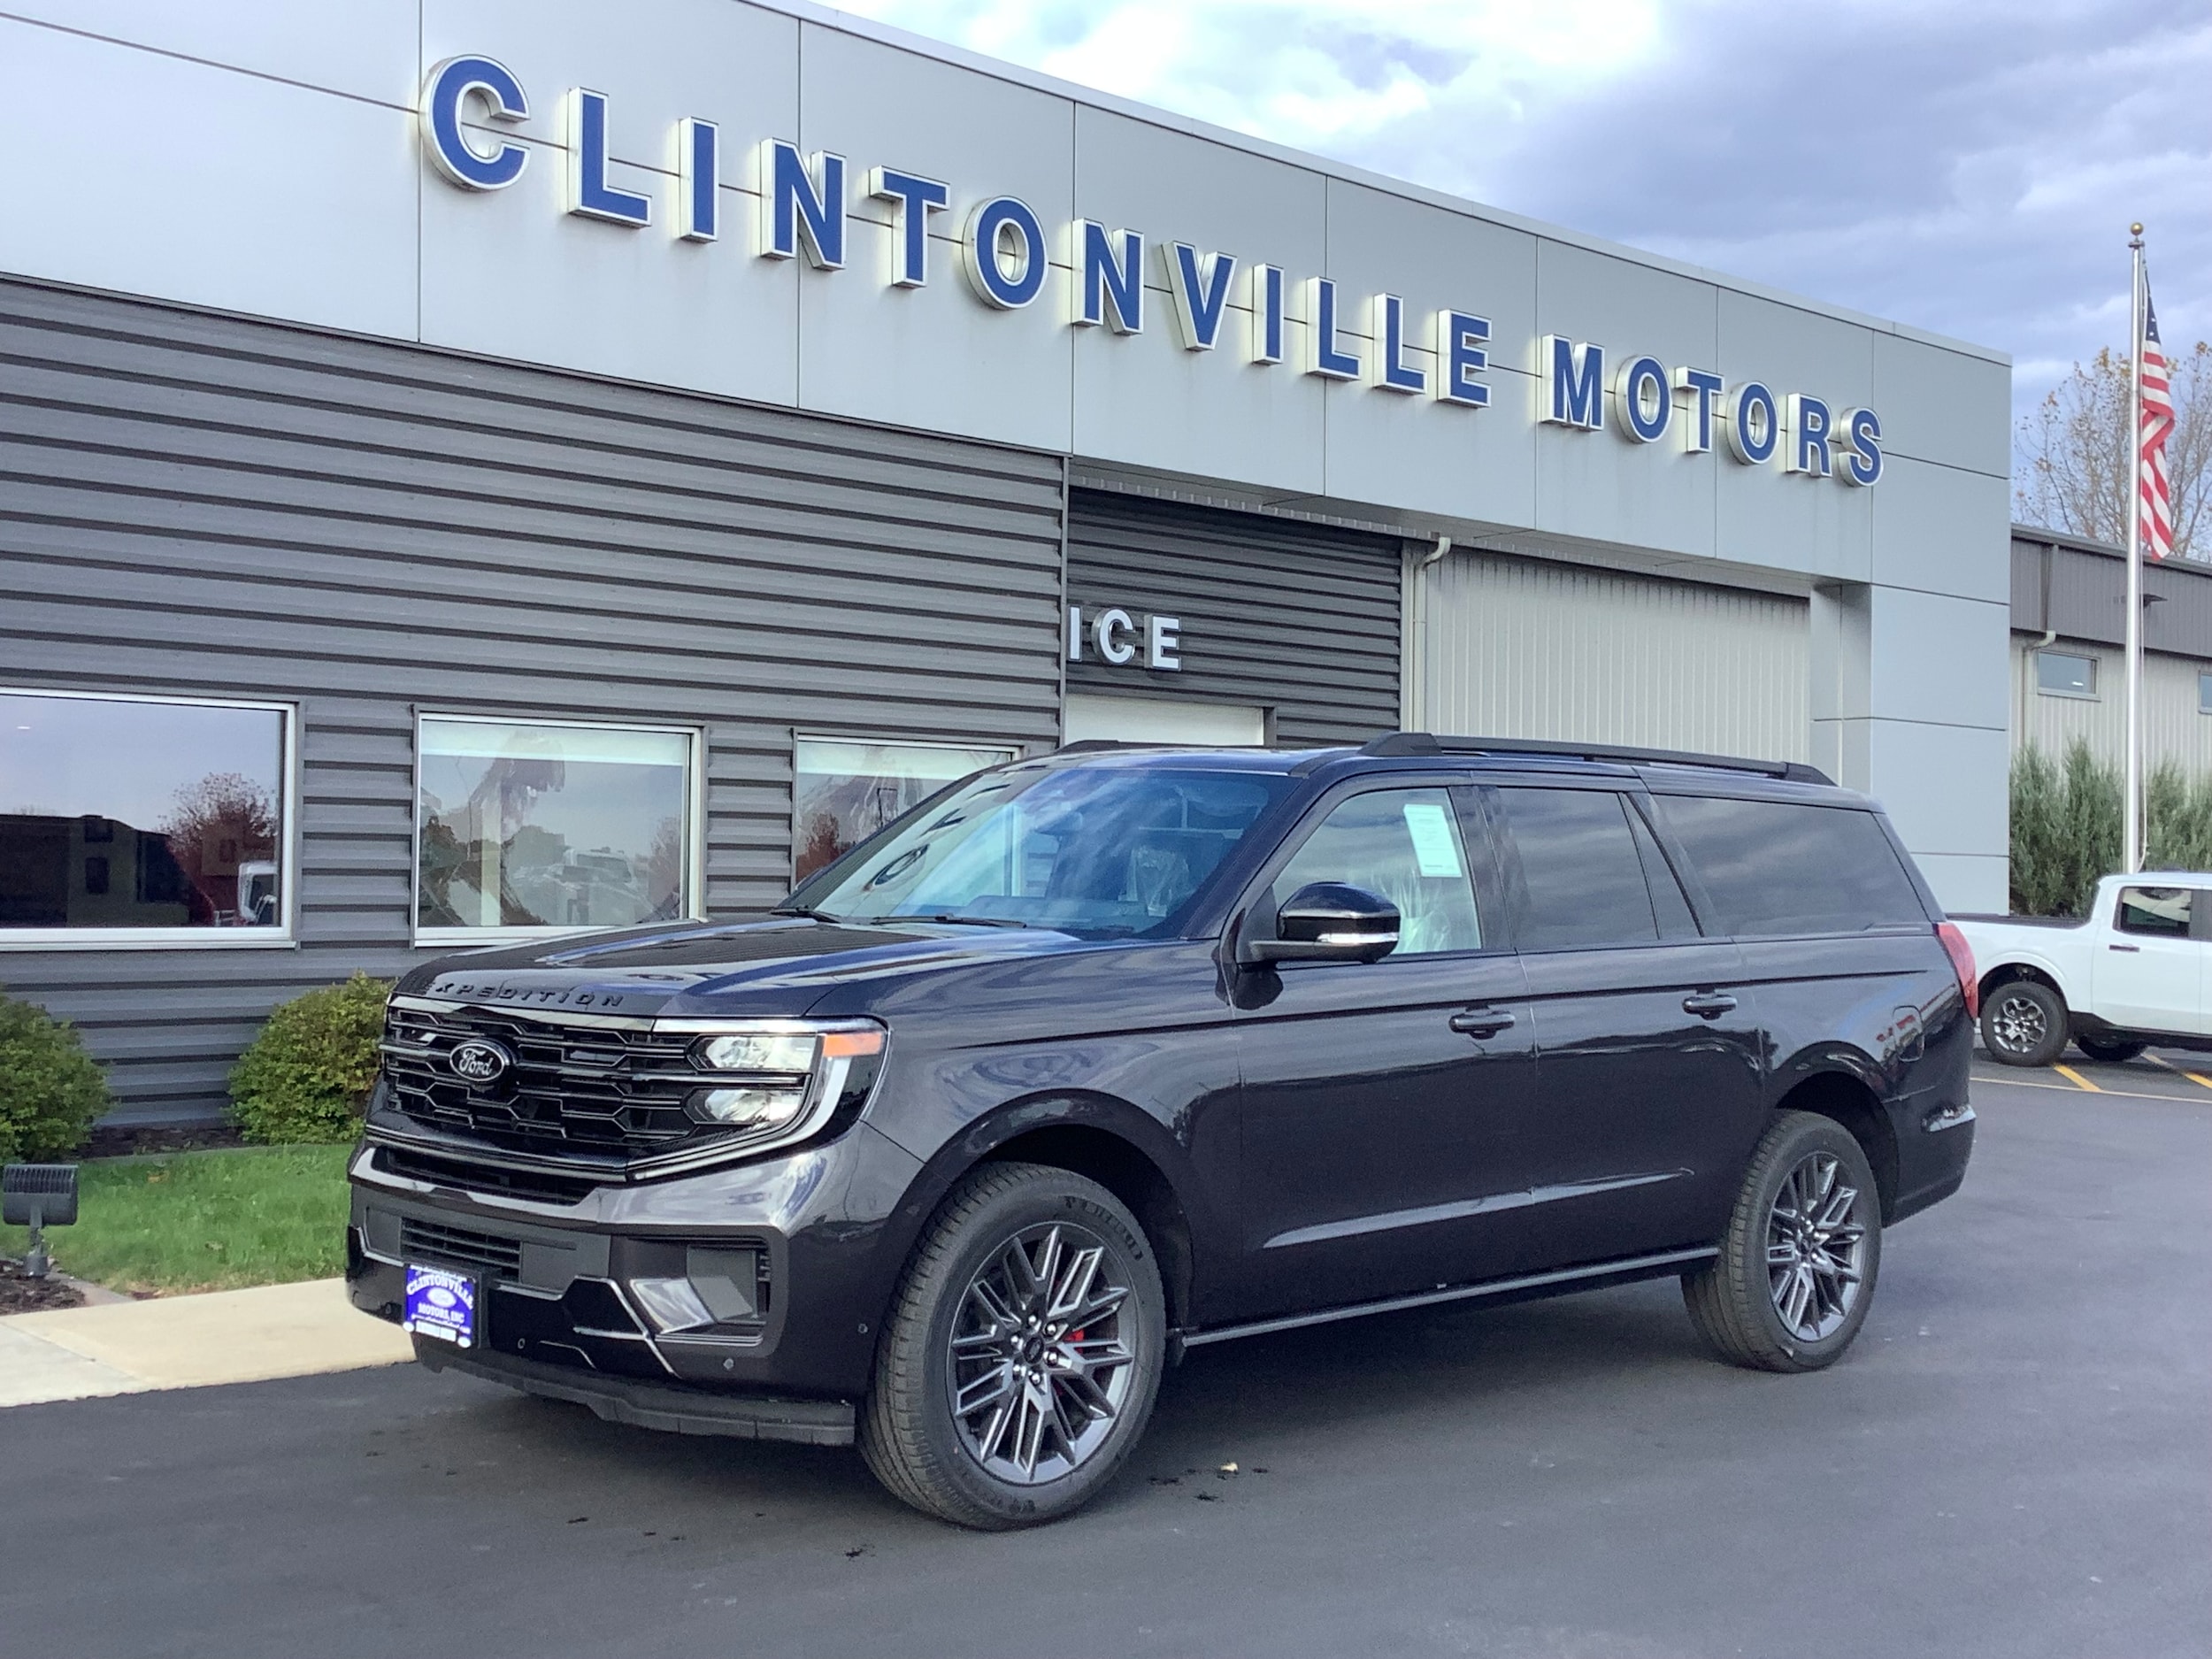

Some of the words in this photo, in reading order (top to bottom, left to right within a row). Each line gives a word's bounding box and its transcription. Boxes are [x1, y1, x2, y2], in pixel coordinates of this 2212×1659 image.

[420, 54, 1492, 409] CLINTONVILLE
[1541, 334, 1884, 488] MOTORS
[423, 980, 624, 1007] XPEDITION
[457, 1047, 495, 1076] Ford
[406, 1274, 473, 1310] CLINTONVILLE
